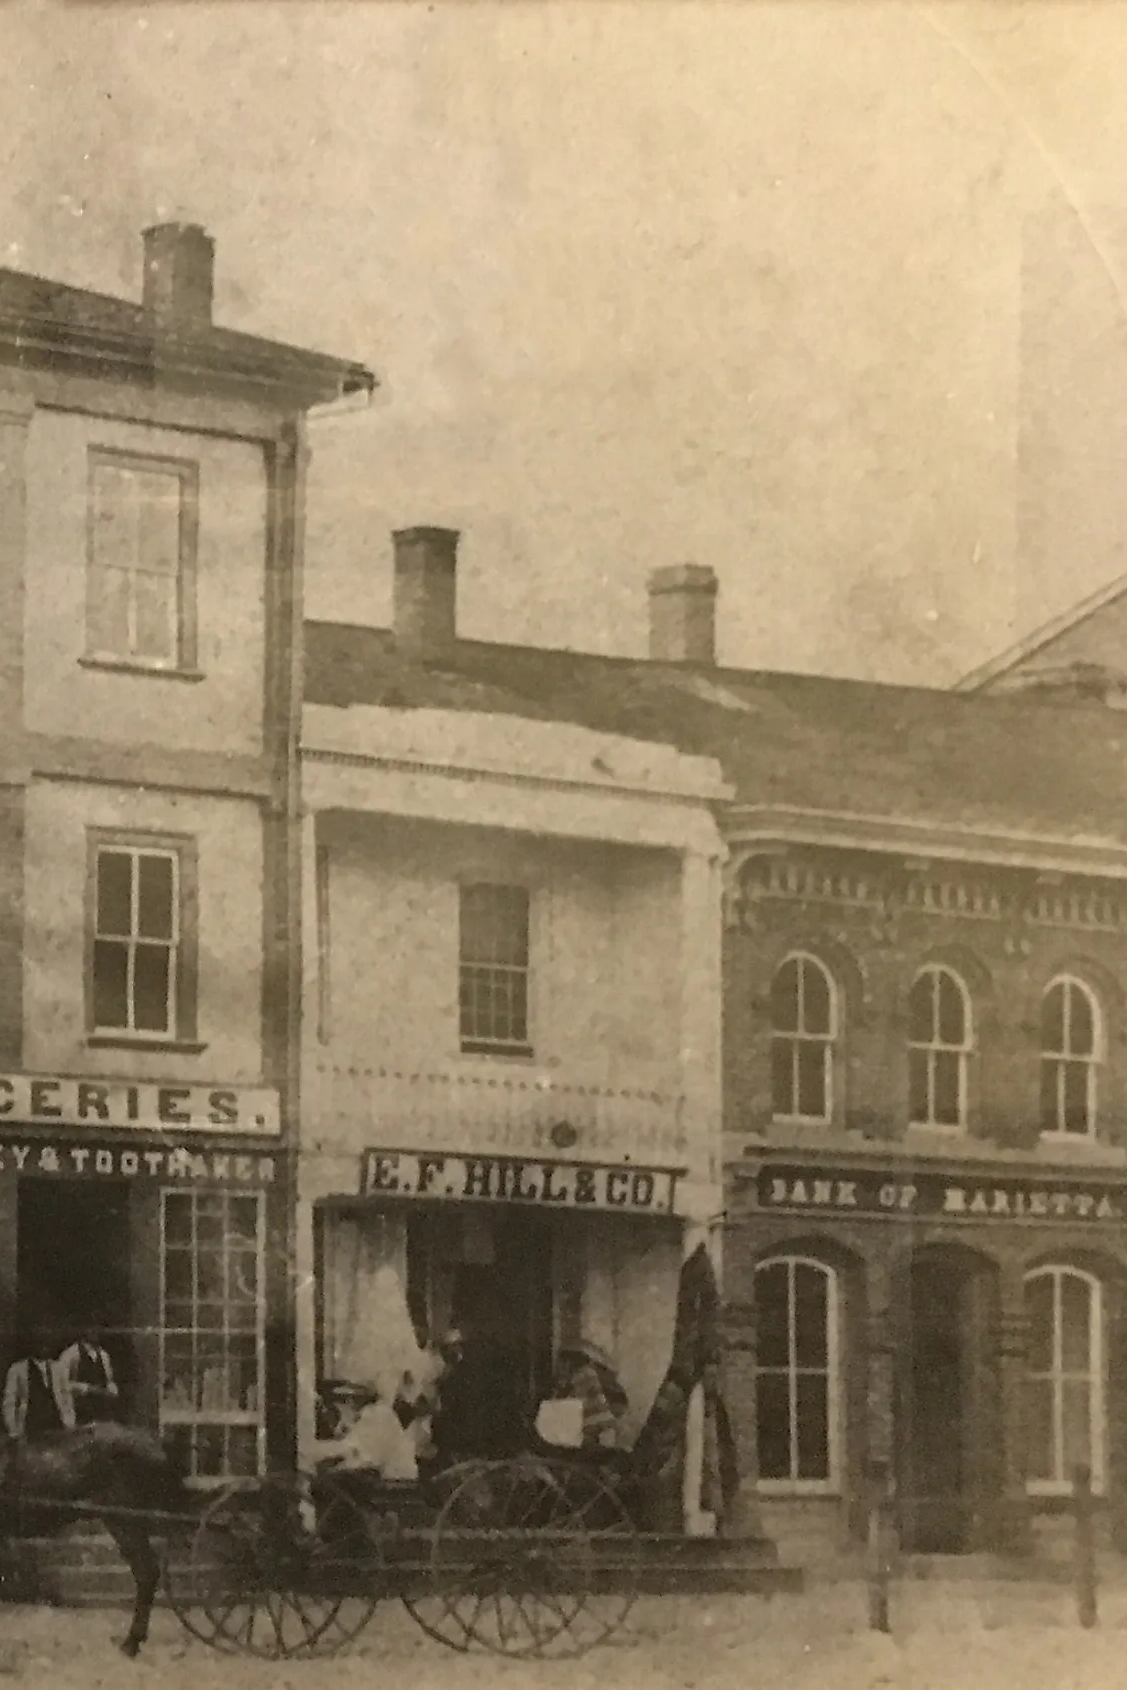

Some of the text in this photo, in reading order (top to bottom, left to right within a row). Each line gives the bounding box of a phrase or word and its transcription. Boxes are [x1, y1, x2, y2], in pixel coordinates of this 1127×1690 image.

[38, 1146, 60, 1172] &
[771, 1180, 857, 1207] BANK
[879, 1184, 917, 1209] OF
